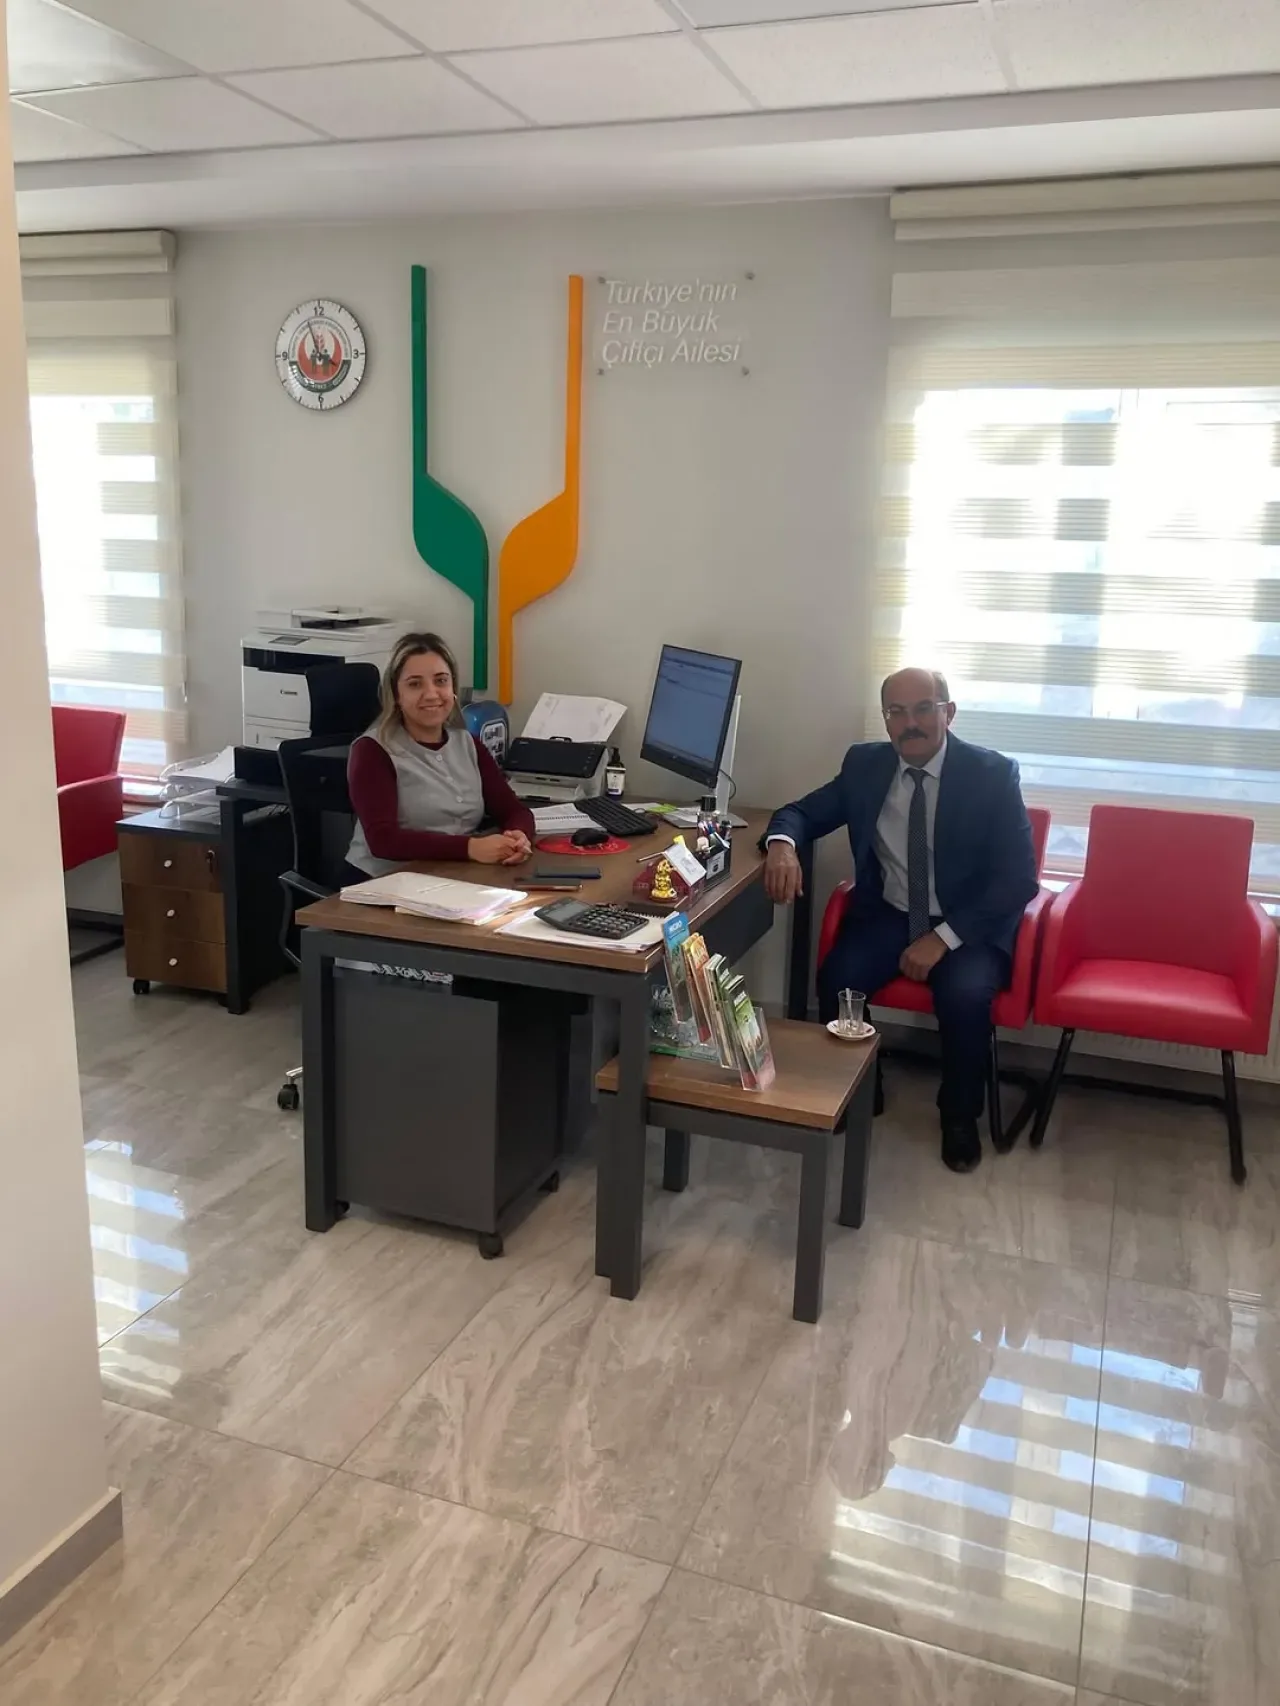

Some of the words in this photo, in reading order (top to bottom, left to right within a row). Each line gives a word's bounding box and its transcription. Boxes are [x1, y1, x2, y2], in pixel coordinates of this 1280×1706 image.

[314, 306, 325, 316] 12
[602, 310, 634, 334] En
[353, 349, 359, 359] 3
[670, 337, 742, 363] Ailesi
[281, 351, 288, 361] 9
[318, 393, 325, 404] 6
